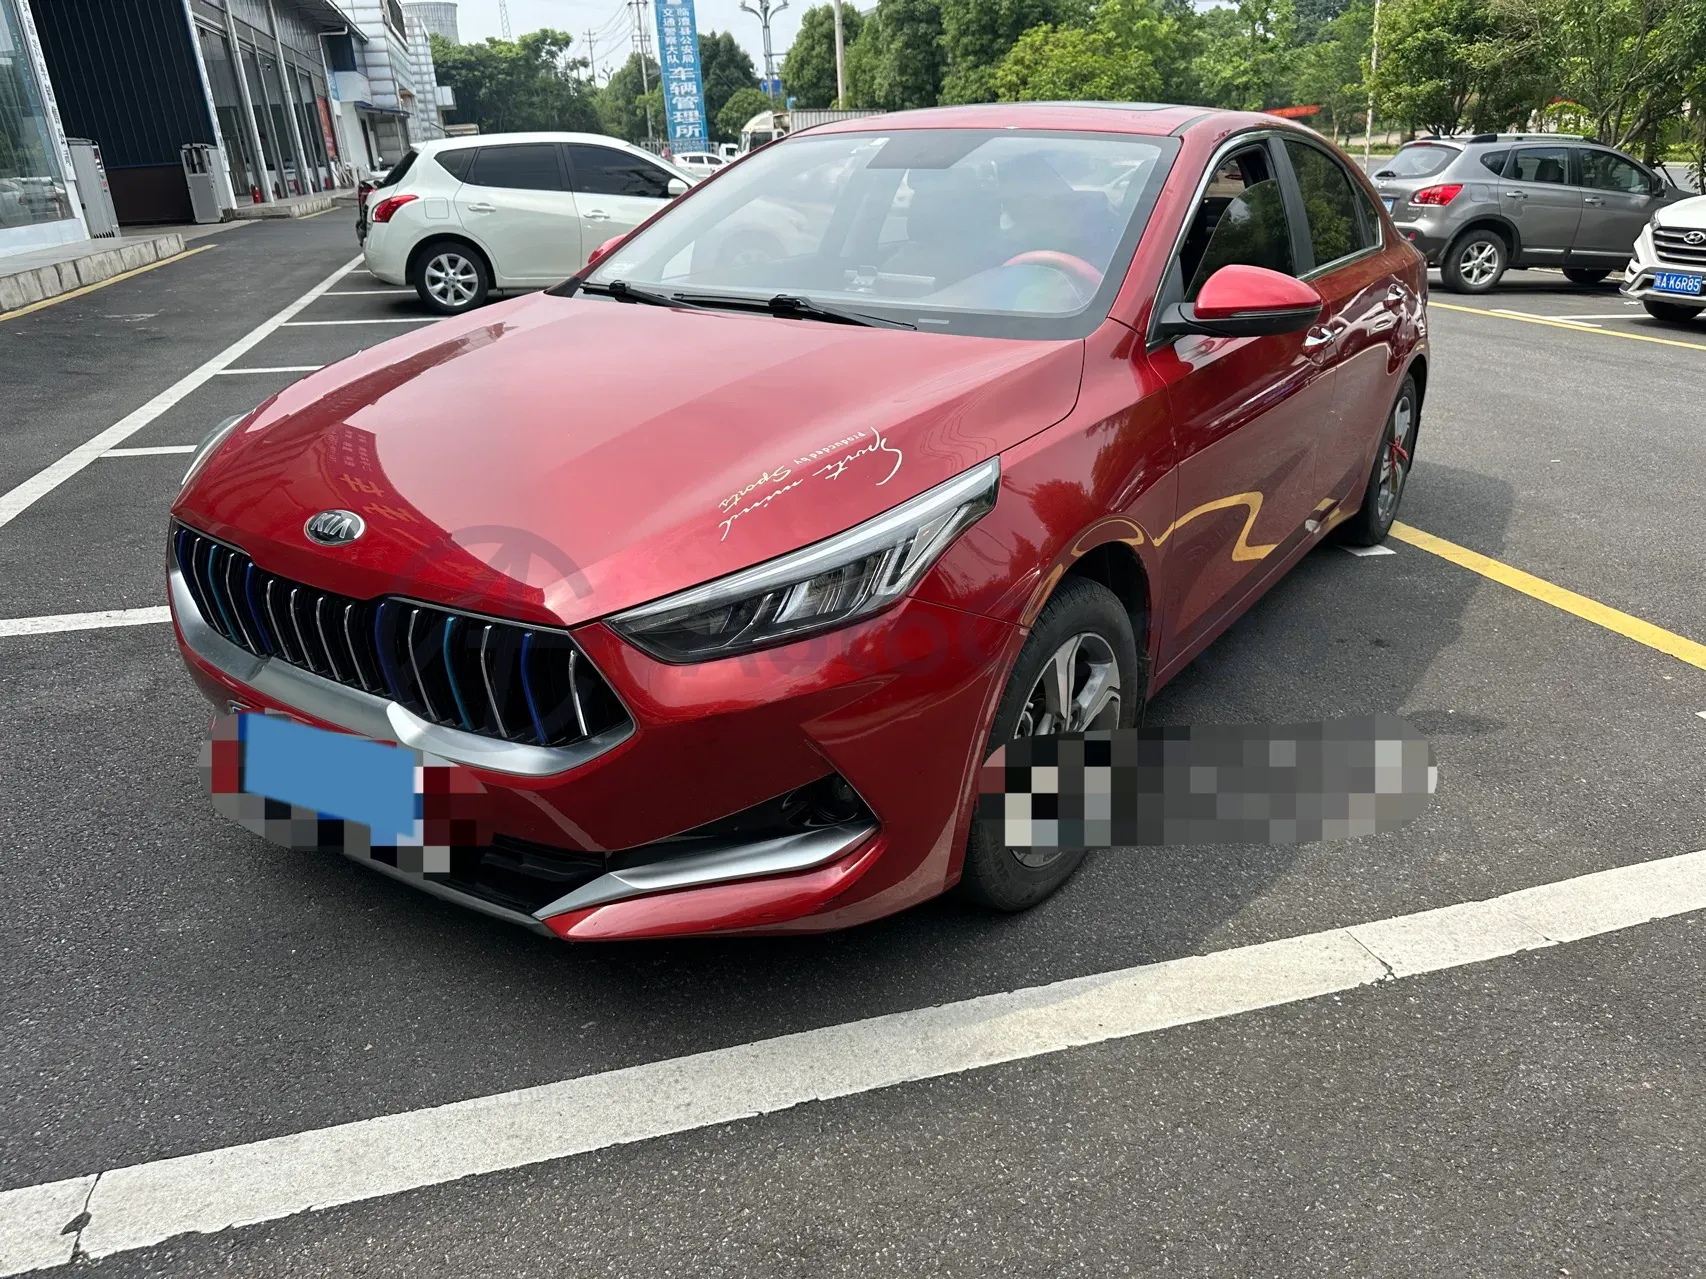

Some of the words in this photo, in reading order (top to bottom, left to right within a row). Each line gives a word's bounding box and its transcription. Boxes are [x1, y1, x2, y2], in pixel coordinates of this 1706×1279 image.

[662, 8, 680, 64] 交通警察大队
[677, 8, 694, 64] 临澧县公安局
[669, 66, 702, 138] 车辆管理所
[718, 465, 791, 514] Sports
[311, 512, 353, 539] KIA
